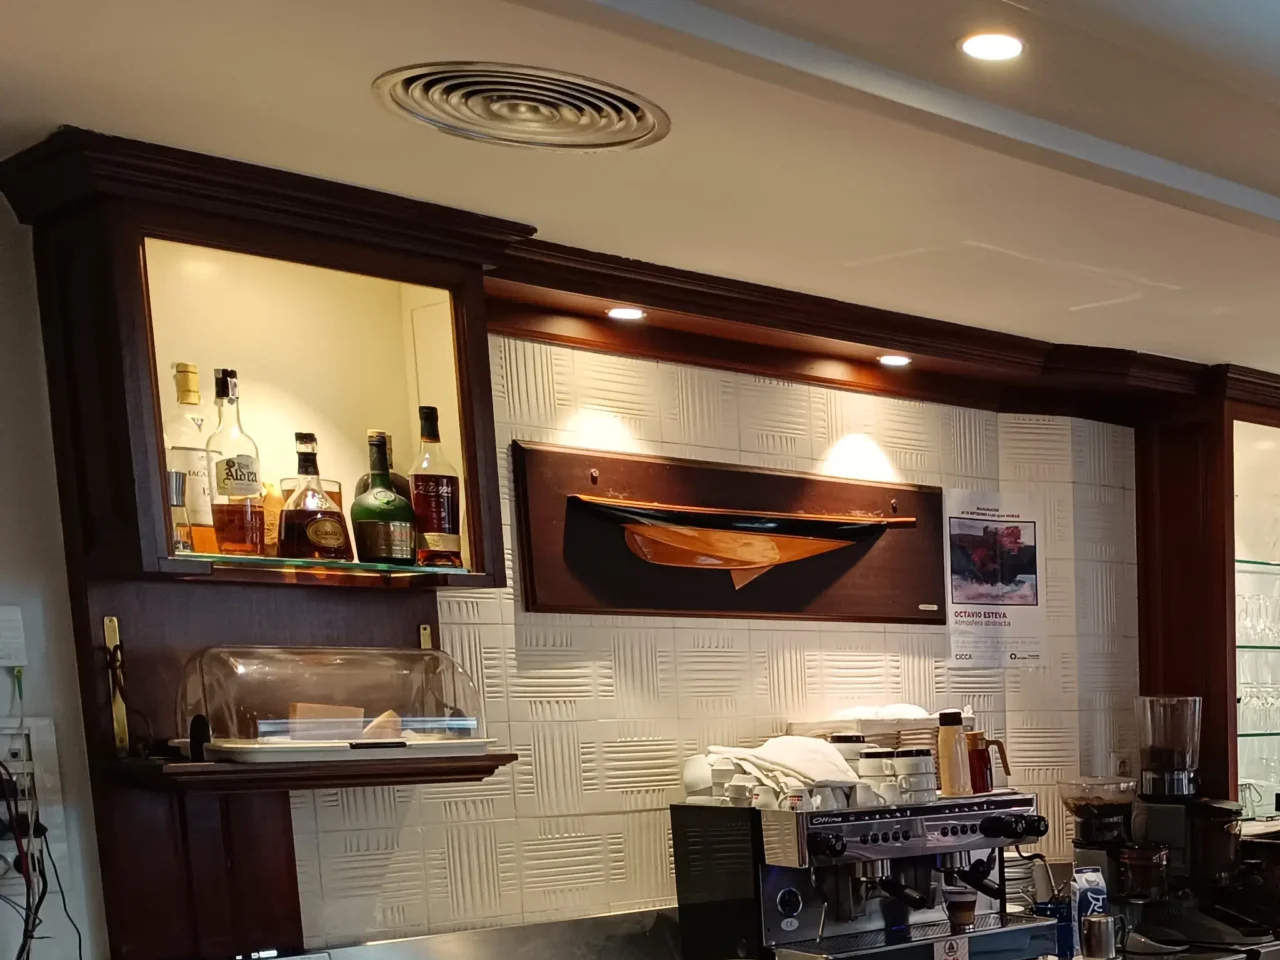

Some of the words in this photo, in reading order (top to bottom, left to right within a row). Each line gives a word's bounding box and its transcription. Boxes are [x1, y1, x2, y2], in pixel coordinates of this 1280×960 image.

[223, 468, 258, 485] Aldea
[954, 611, 982, 619] OCTAVIO
[955, 653, 973, 661] CICCA
